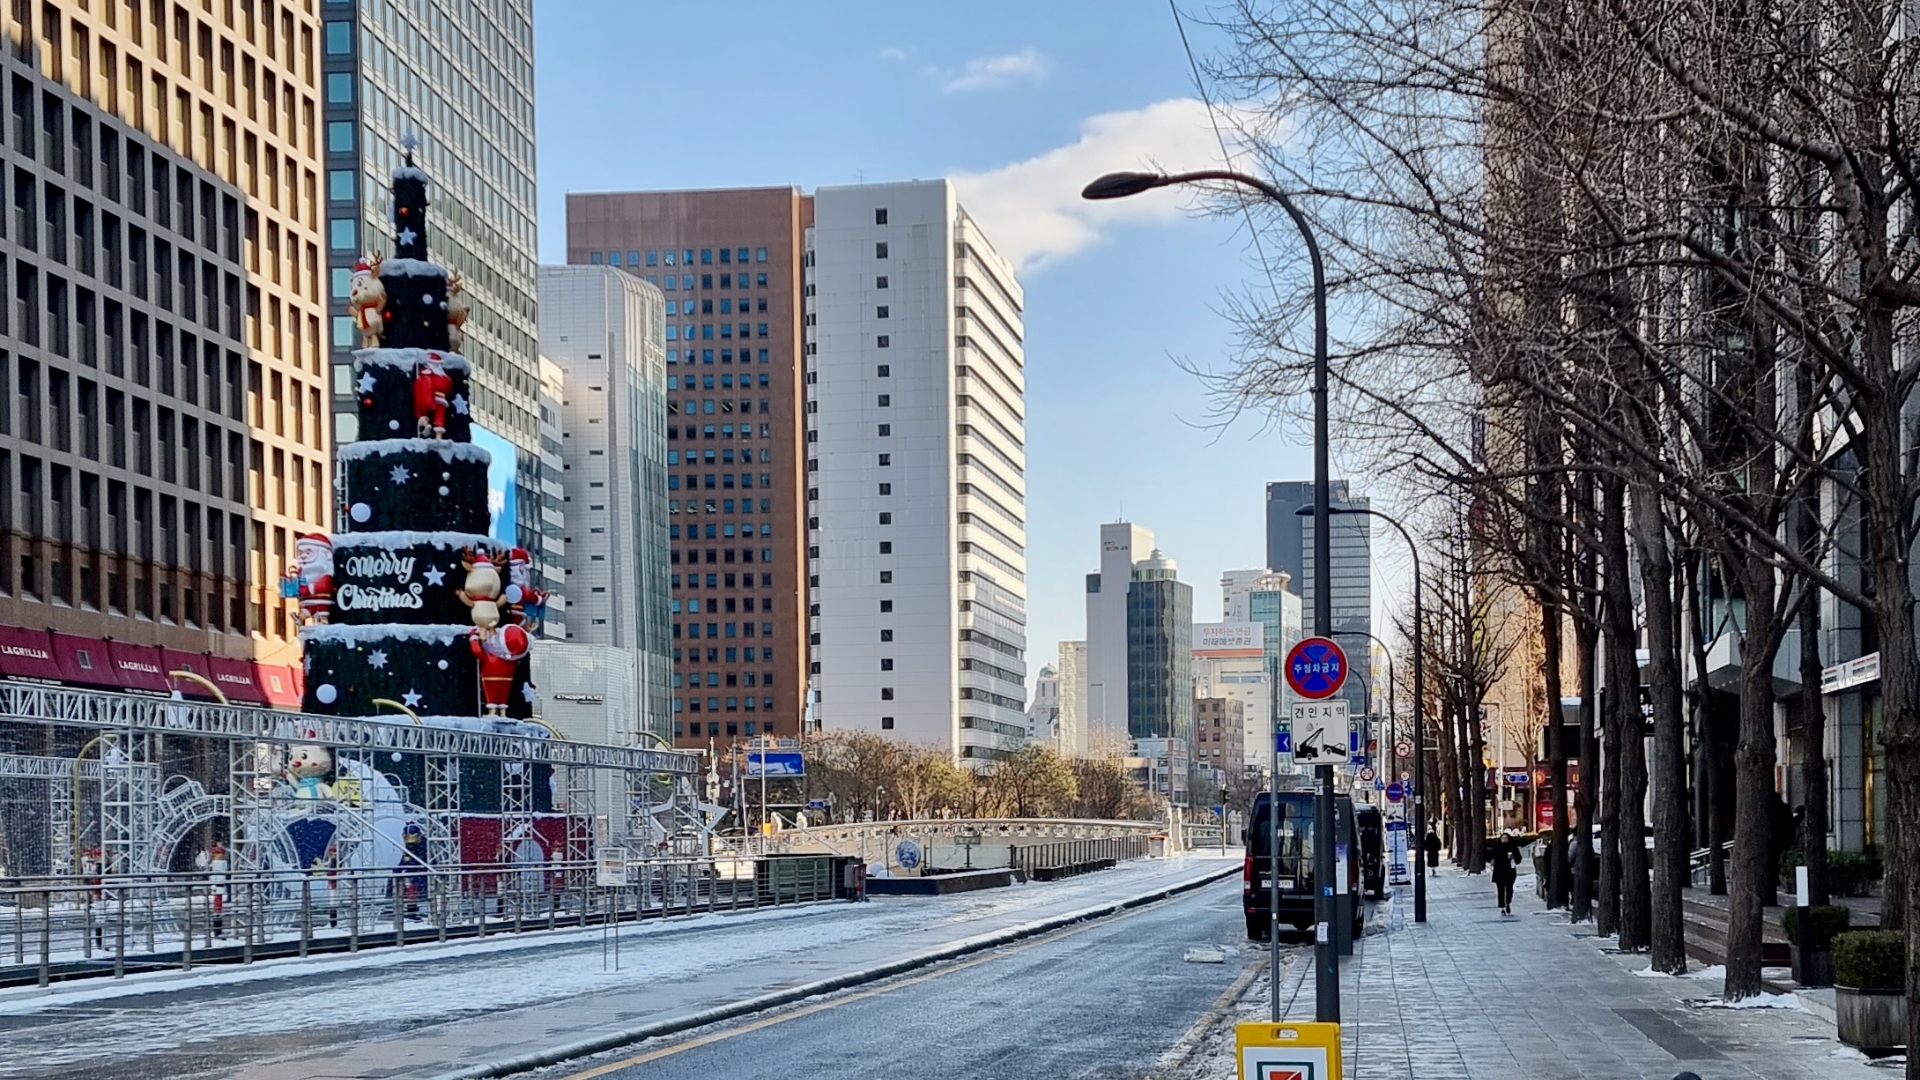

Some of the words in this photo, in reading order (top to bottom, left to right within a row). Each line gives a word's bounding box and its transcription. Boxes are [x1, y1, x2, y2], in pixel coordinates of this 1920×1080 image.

[345, 551, 416, 584] Merry
[336, 582, 424, 612] Christmas
[1203, 627, 1233, 637] 투자하는
[1203, 637, 1251, 646] 미래에셋증권
[0, 645, 49, 660] LAGRILLIA
[118, 660, 159, 673] LAGRILLIA
[1294, 662, 1340, 674] 주정차금지
